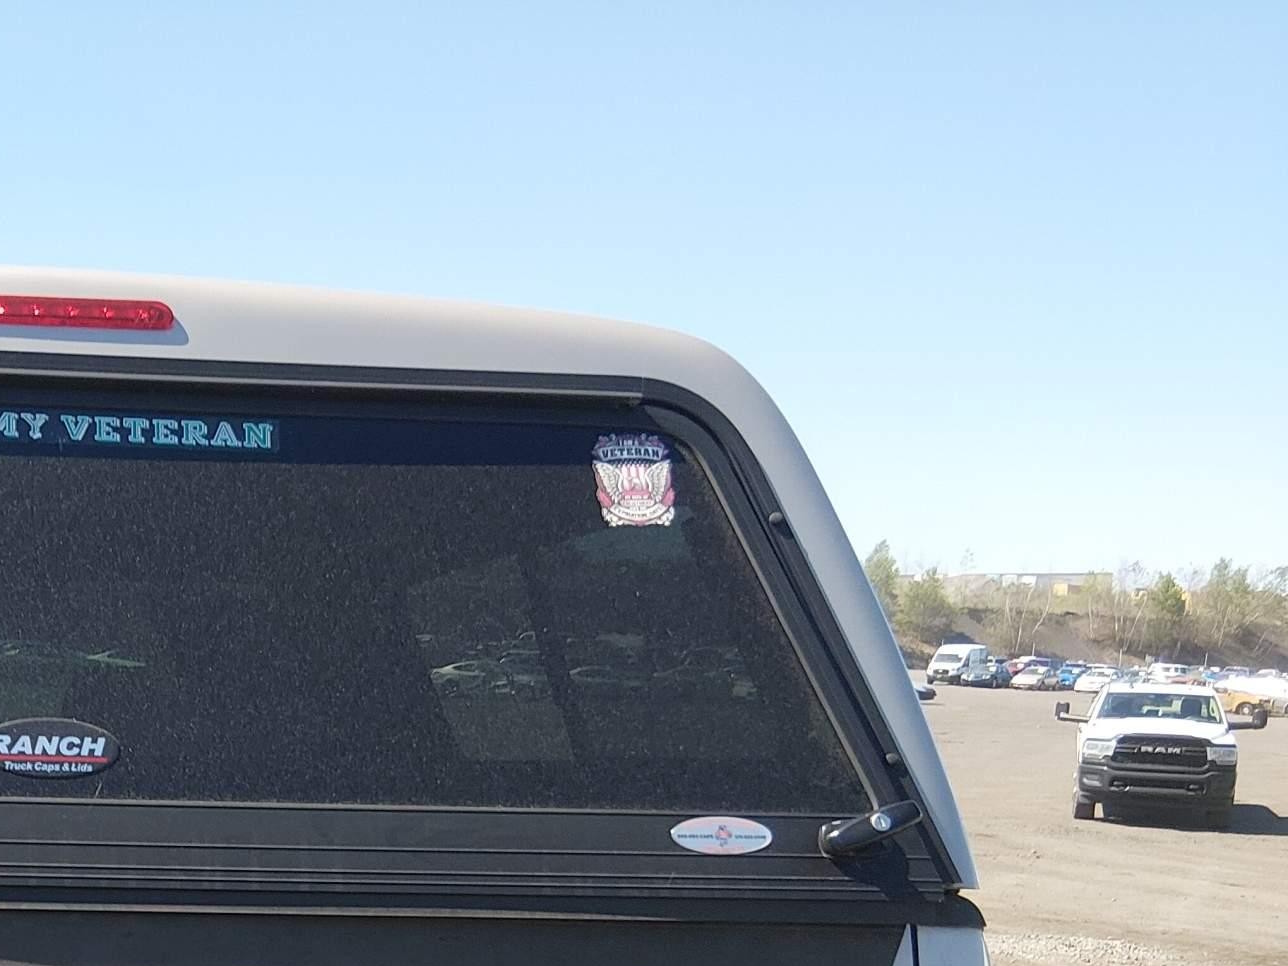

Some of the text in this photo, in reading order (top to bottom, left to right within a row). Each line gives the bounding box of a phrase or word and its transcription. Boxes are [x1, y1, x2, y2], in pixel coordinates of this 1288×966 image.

[60, 414, 274, 449] VETERAN
[601, 447, 660, 458] VETERAN
[1140, 746, 1182, 754] RAM
[3, 761, 93, 773] Truck Caps & Lids
